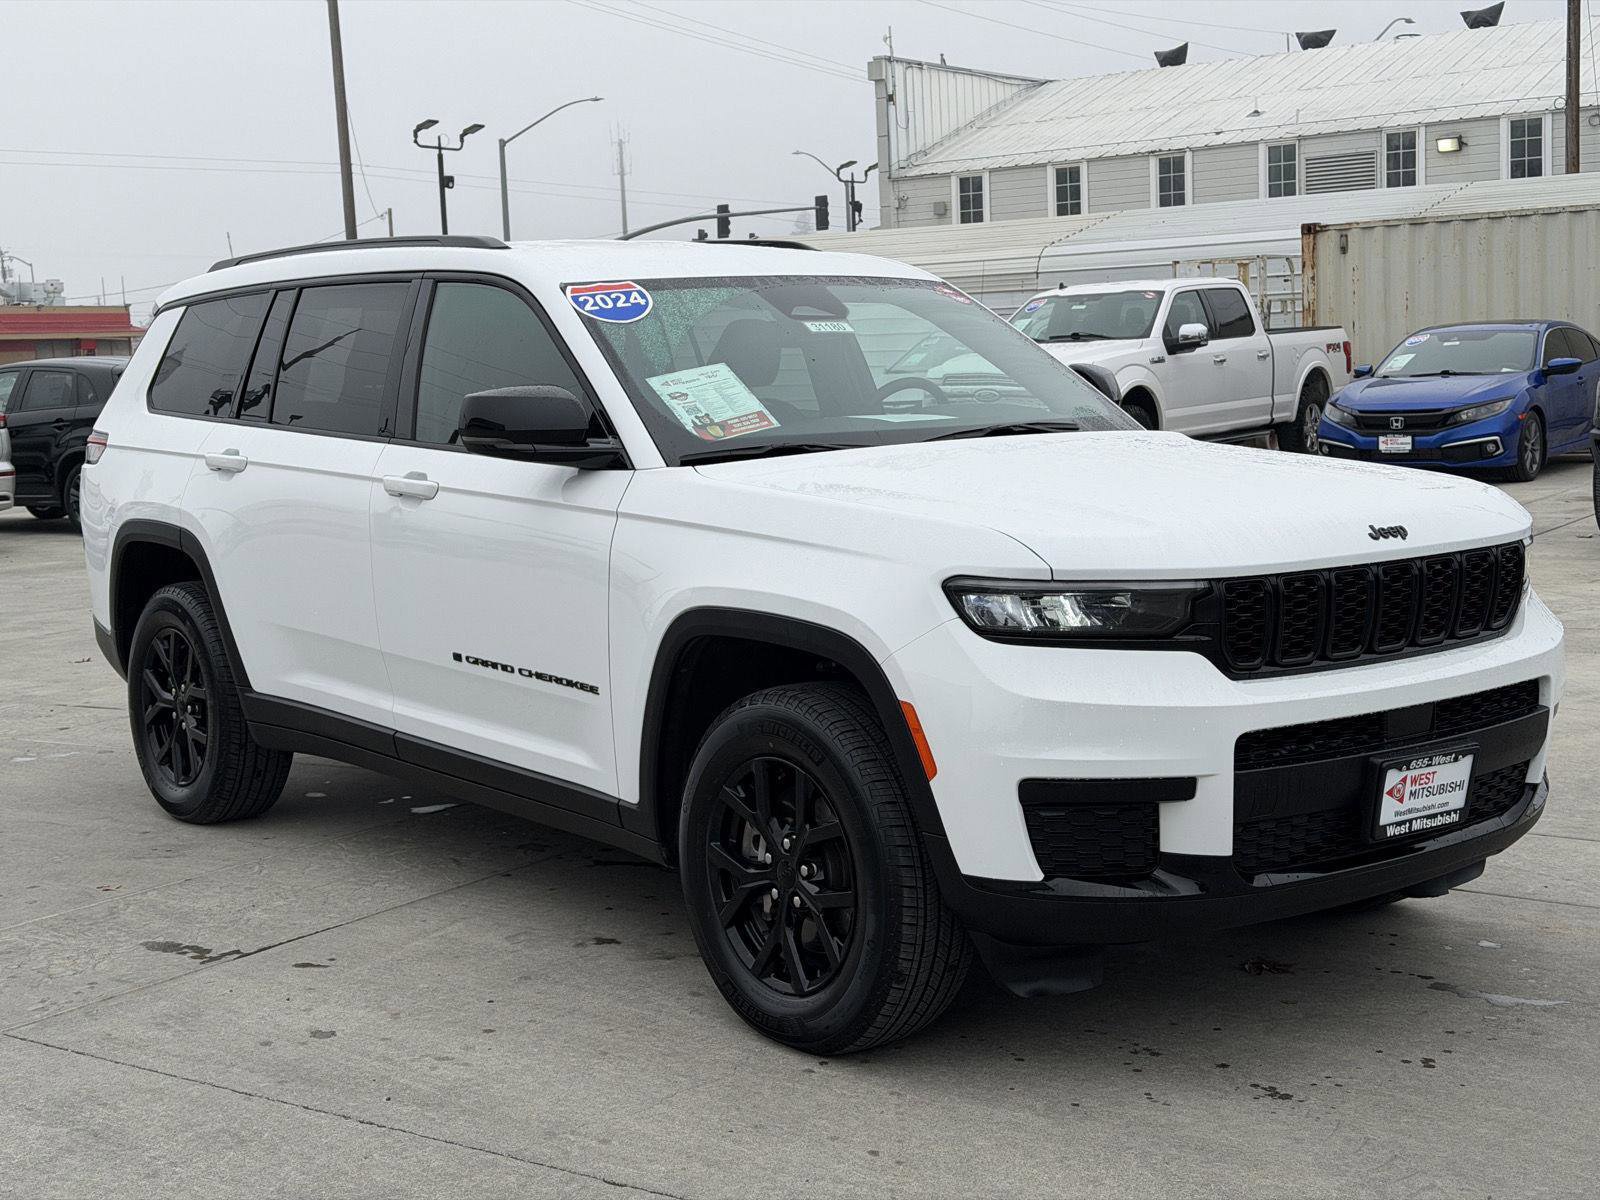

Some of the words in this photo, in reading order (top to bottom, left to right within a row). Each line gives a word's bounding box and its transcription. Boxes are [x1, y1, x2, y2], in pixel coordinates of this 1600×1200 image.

[578, 291, 647, 311] 2024
[1326, 342, 1341, 354] FX4
[1368, 524, 1409, 541] Jeep
[465, 655, 515, 674] GRAND
[518, 667, 600, 696] CHEROKEE
[1409, 753, 1455, 769] 655-West
[1410, 771, 1437, 788] WEST
[1408, 780, 1465, 800] MITSUBISHI
[1386, 822, 1410, 837] West
[1411, 811, 1460, 831] Mitsubishi
